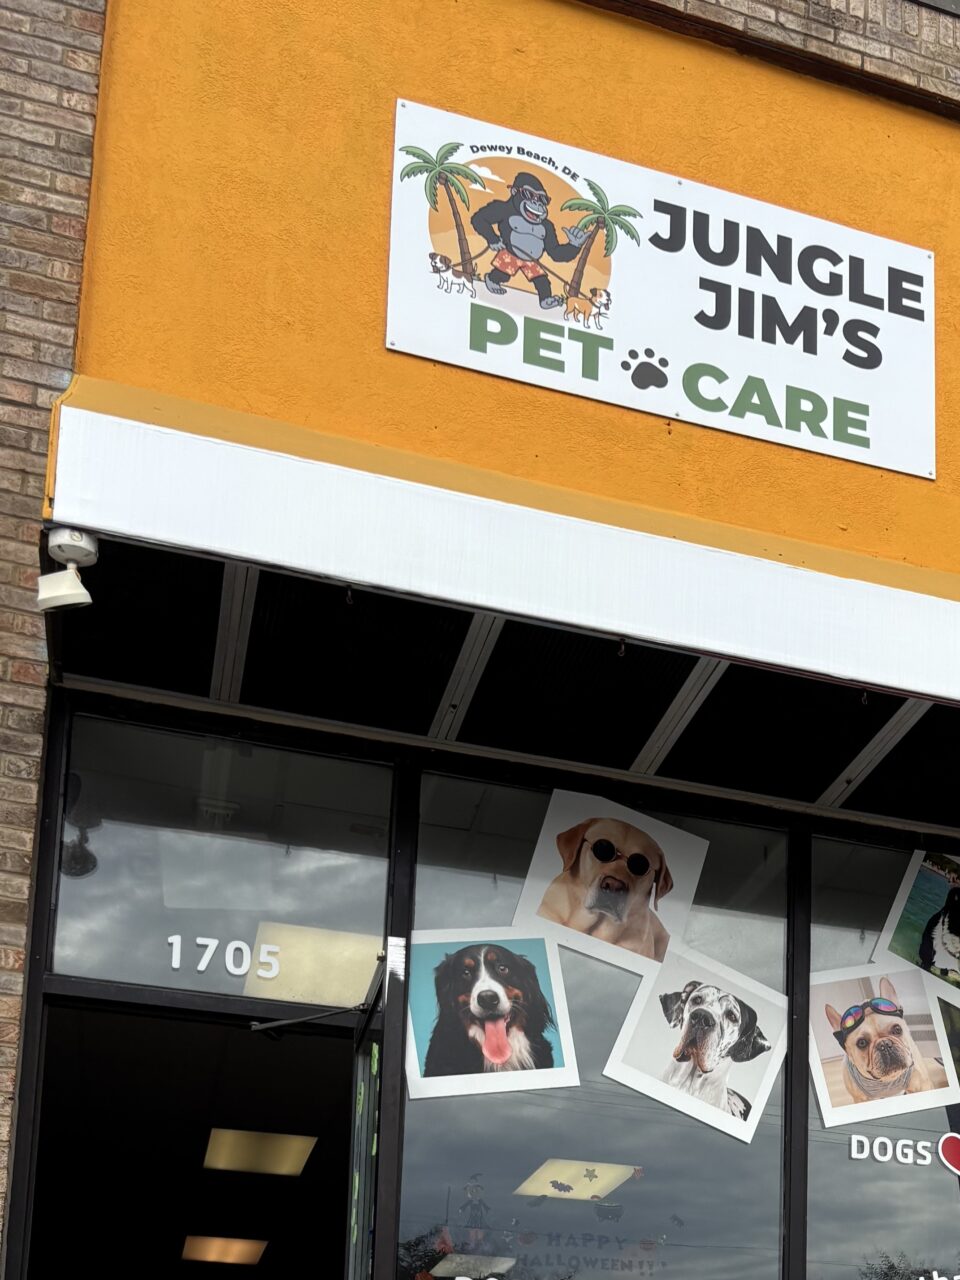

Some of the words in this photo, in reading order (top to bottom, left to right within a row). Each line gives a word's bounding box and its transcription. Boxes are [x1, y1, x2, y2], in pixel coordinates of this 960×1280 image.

[469, 144, 513, 155] Dewey
[516, 146, 560, 171] Beach,
[561, 165, 580, 182] DE
[648, 198, 926, 322] JUNGLE
[693, 278, 883, 370] JIM'S
[468, 302, 614, 382] PET
[682, 362, 871, 449] CARE
[167, 935, 281, 979] 1705
[850, 1134, 932, 1165] DOGS
[547, 1232, 628, 1251] HAPPY
